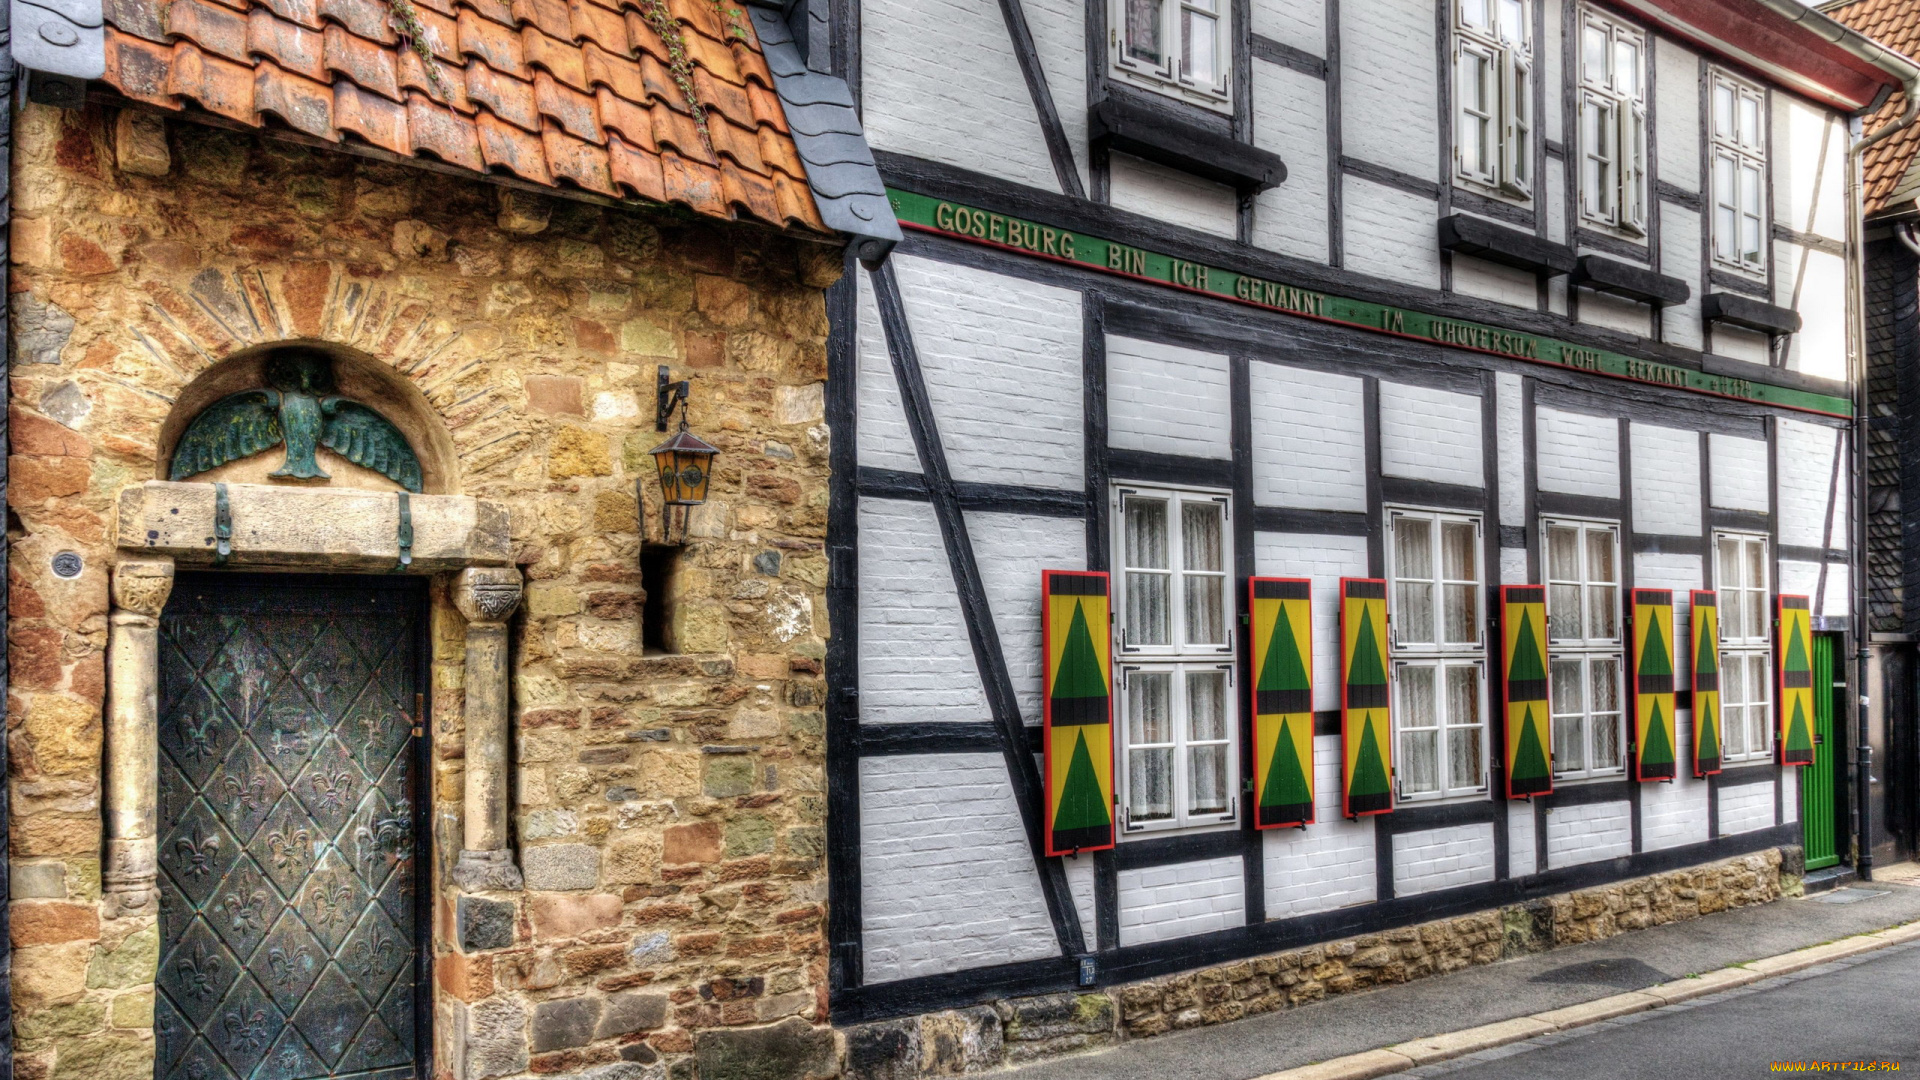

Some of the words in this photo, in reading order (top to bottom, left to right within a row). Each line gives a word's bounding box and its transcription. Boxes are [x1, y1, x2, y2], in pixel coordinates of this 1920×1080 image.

[936, 202, 1075, 259] GOSEBURG
[1108, 243, 1147, 275] BIN
[1172, 258, 1209, 290] ICH
[1236, 275, 1326, 316] GENANNT
[1381, 309, 1405, 334] IM
[1431, 320, 1539, 360] UHUVERSUM
[1627, 359, 1689, 387] BEKANNT
